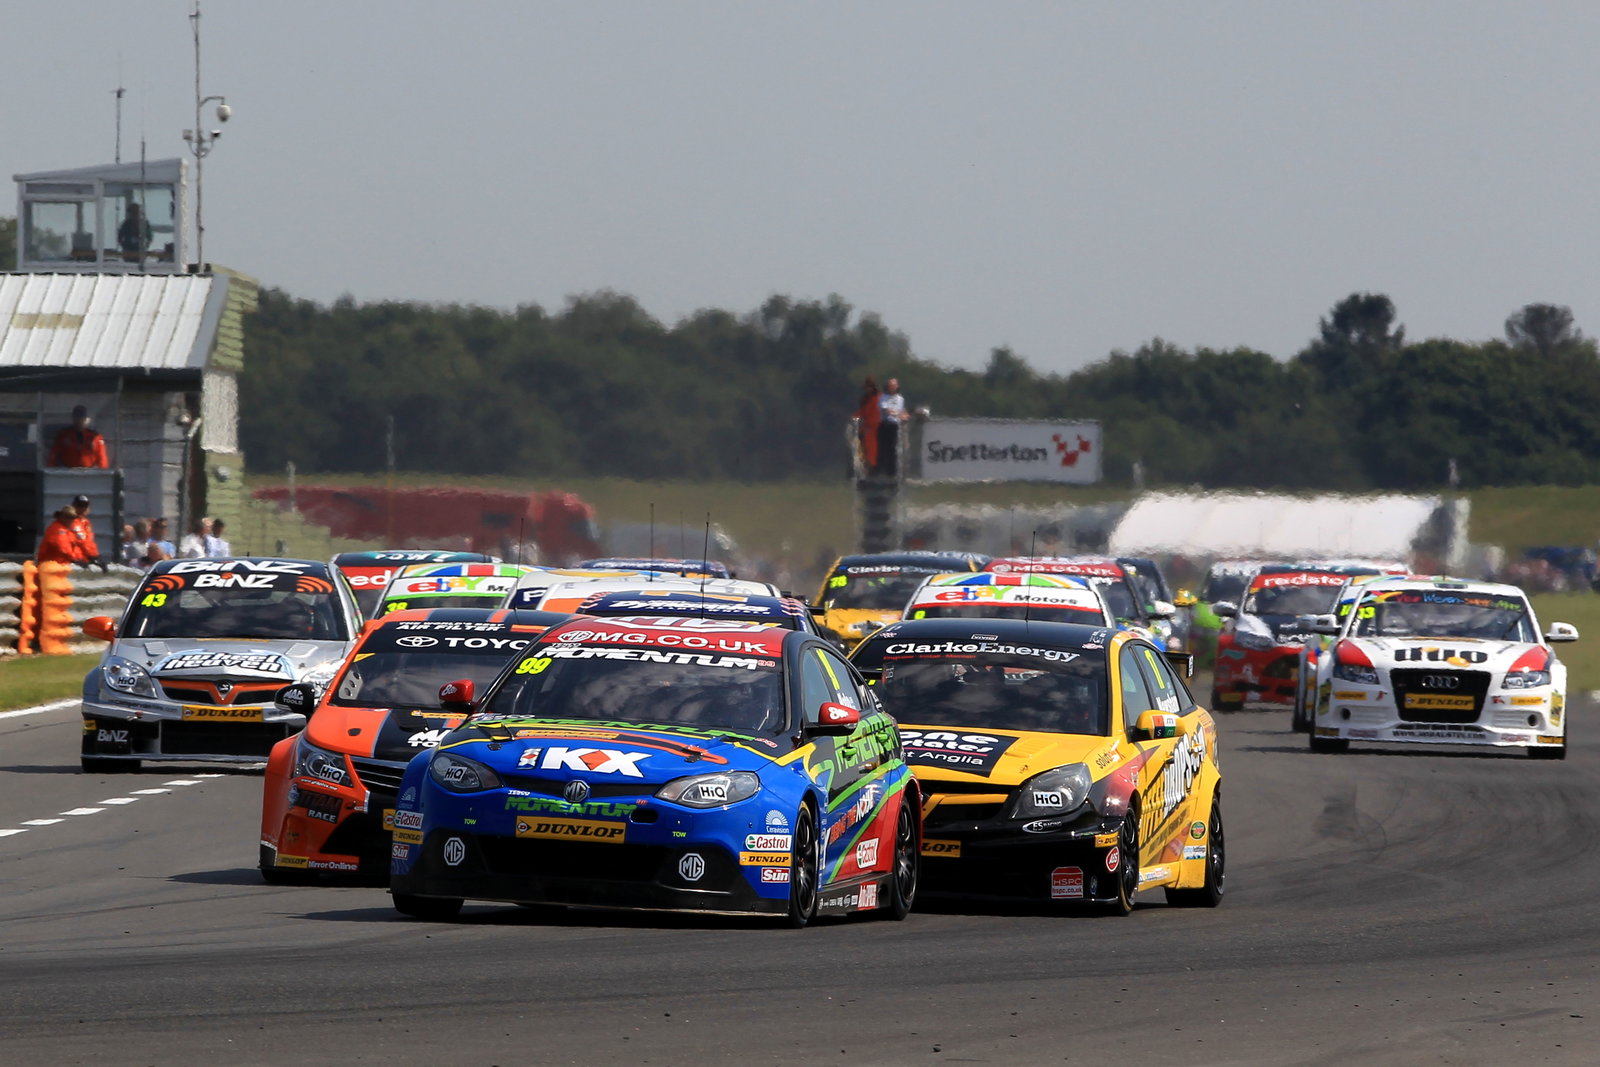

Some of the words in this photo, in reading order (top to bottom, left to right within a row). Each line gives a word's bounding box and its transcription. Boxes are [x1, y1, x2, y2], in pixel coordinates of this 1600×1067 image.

[926, 441, 1048, 463] Snetterton
[193, 572, 279, 588] BiNZ
[141, 594, 167, 608] 43
[1014, 595, 1078, 605] Motors
[592, 632, 769, 655] MG.CO.UK
[181, 653, 279, 663] wheel
[534, 646, 758, 671] MOMENTUM
[164, 659, 283, 672] heaven
[516, 657, 552, 675] 99
[196, 708, 262, 718] DUNLOP
[97, 728, 129, 743] BiNZ
[919, 751, 984, 765] Anglia
[320, 767, 342, 781] HiQ
[444, 767, 464, 779] HiQ
[700, 786, 725, 799] HiQ
[1034, 794, 1061, 805] HiQ
[504, 796, 638, 817] MOMENTUM
[308, 809, 337, 823] RACE
[529, 822, 624, 838] DUNLOP
[756, 836, 789, 849] Castrol
[749, 855, 789, 863] DUNLOP
[762, 869, 790, 881] Sun
[1053, 877, 1082, 886] HSPC
